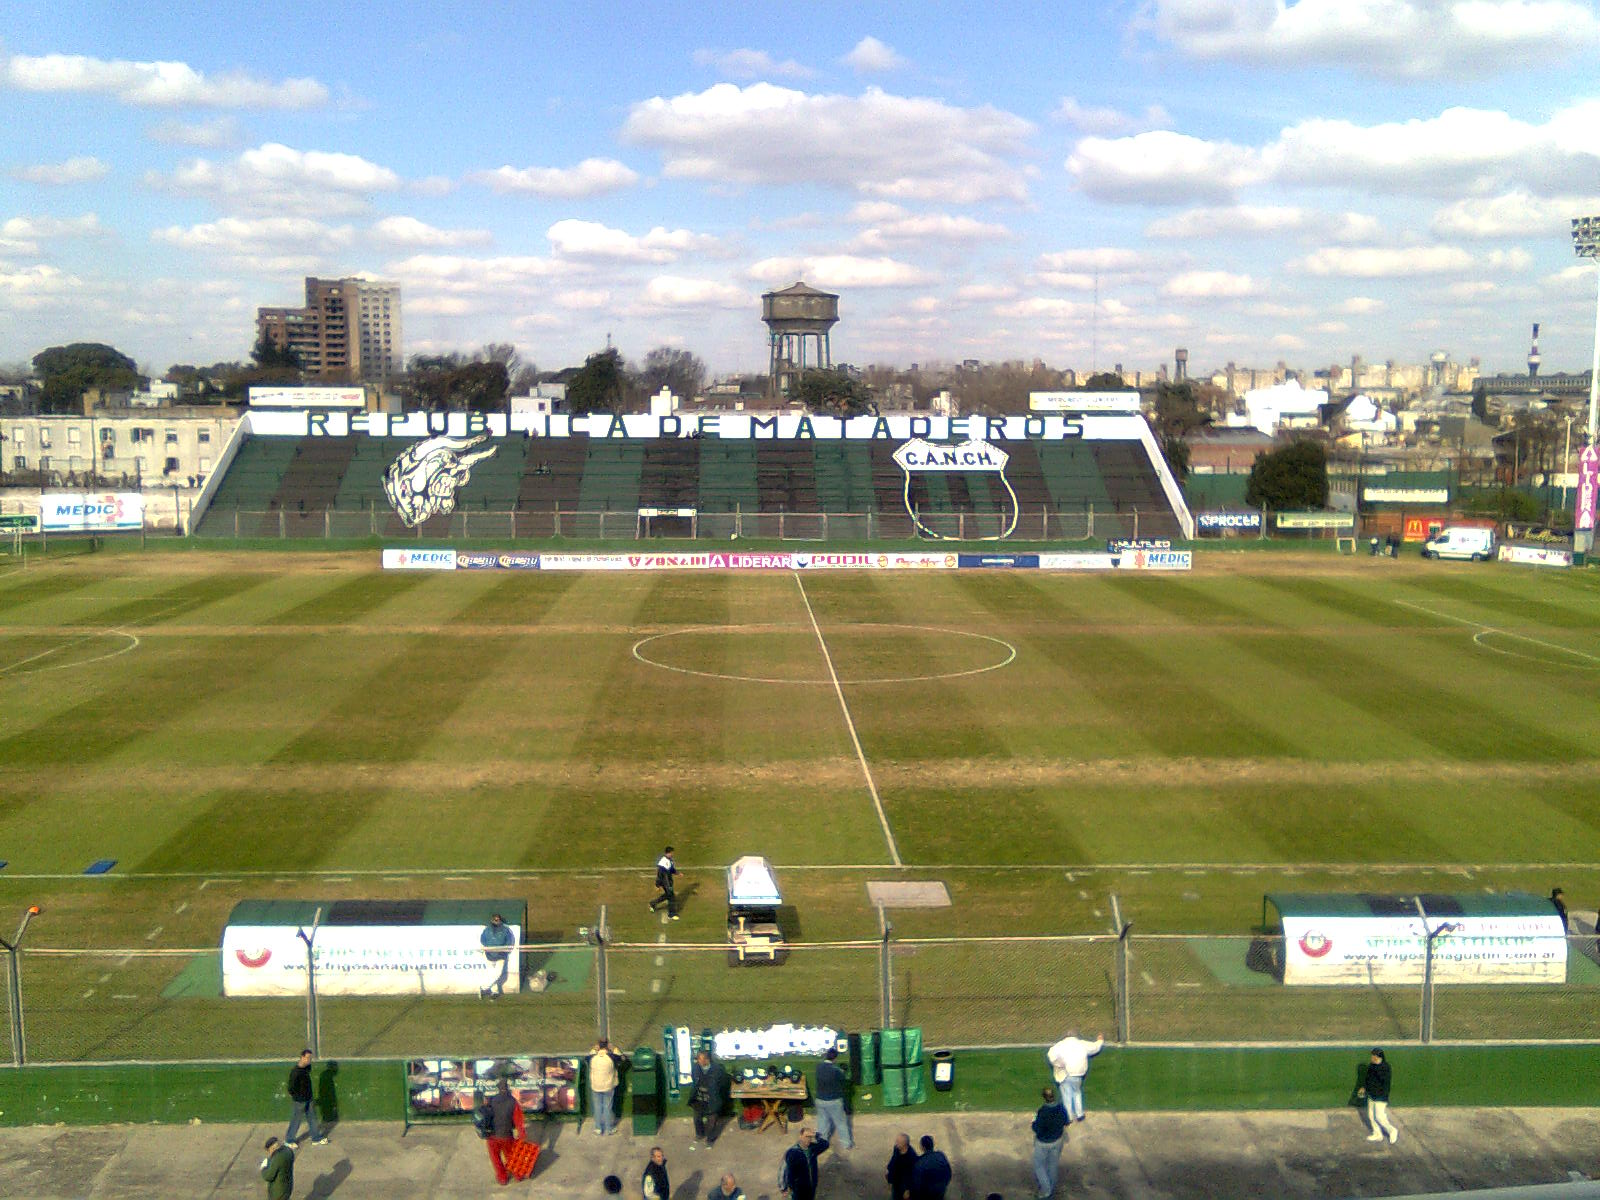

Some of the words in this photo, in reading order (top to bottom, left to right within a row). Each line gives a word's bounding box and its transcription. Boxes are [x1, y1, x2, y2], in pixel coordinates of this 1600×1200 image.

[307, 411, 630, 439] REPUBLICA
[659, 414, 721, 439] DE
[750, 414, 1084, 440] MATADEROS
[905, 451, 998, 466] C.A.N.CH.
[56, 504, 115, 516] MEDIC
[410, 553, 452, 563] MEDIC
[729, 554, 792, 568] LIDERAR
[1148, 553, 1190, 563] MEDIC
